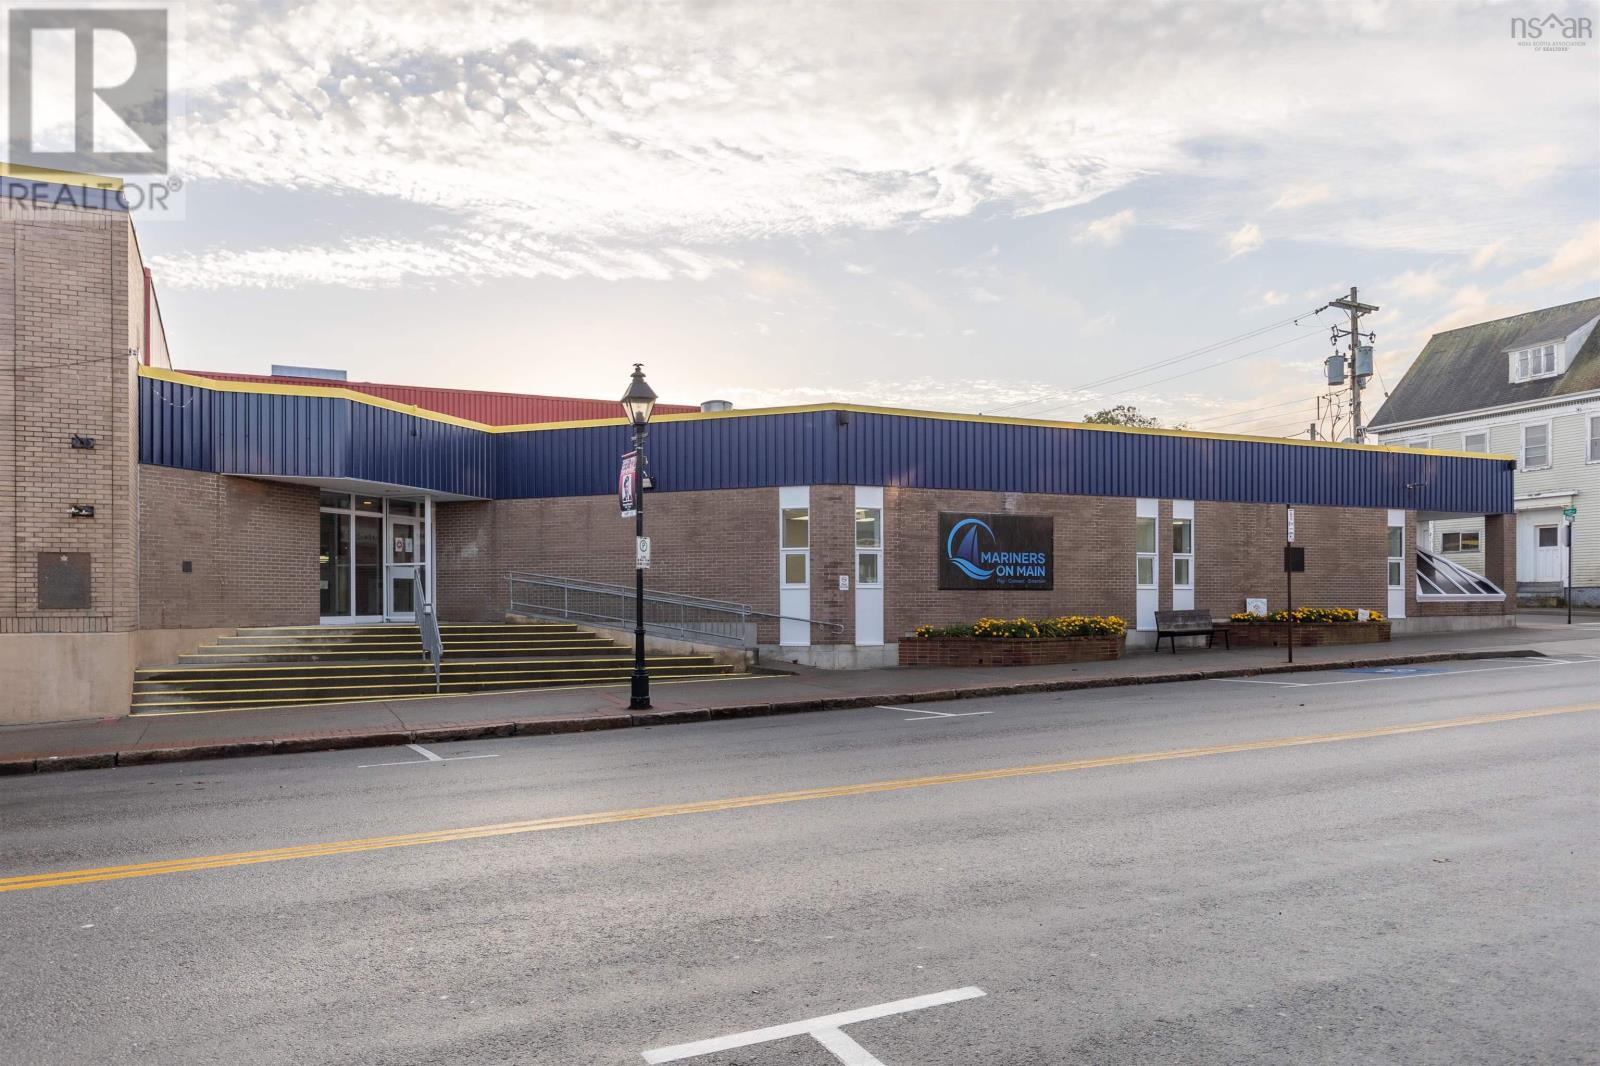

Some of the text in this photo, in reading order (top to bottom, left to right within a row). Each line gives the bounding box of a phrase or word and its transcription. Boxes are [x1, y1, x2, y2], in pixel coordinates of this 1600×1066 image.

[981, 552, 1046, 564] MARINERS
[996, 565, 1046, 577] ON MAIN
